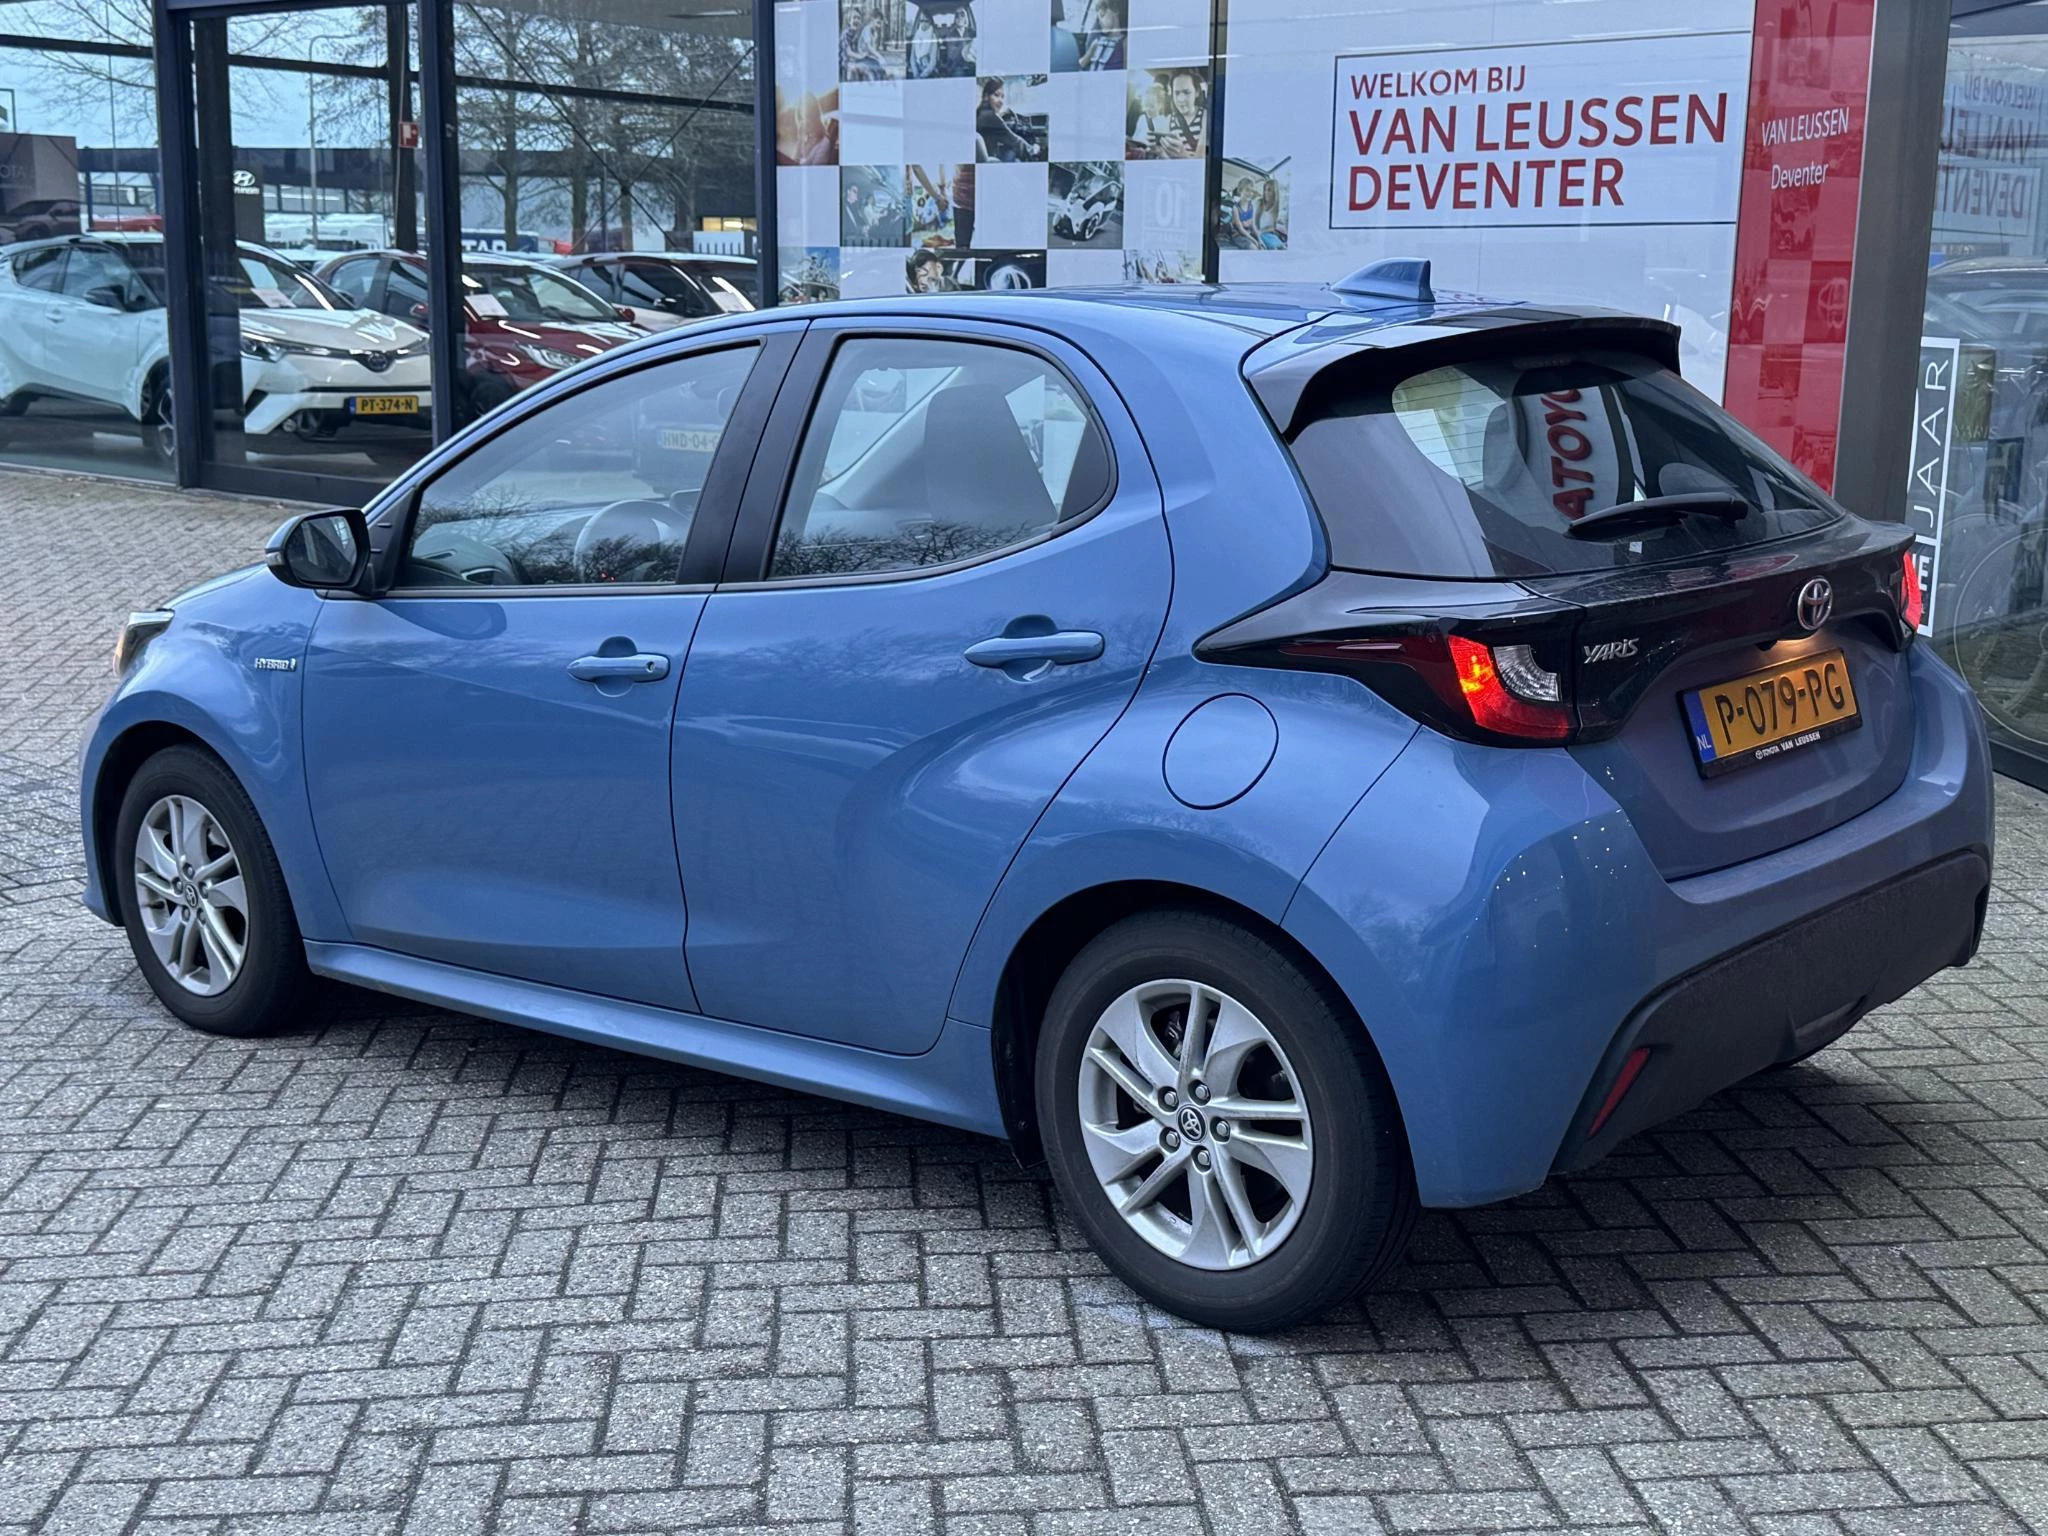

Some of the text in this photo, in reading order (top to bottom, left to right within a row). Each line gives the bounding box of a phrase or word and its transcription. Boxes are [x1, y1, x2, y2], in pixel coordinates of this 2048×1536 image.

[1351, 65, 1527, 100] WELKOM BIJ
[1349, 92, 1729, 156] VAN LEUSSEN
[1762, 107, 1850, 147] VAN LEUSSEN
[1348, 157, 1625, 212] DEVENTER
[1770, 160, 1829, 190] Deventer
[361, 398, 413, 411] PT-374-N
[1914, 359, 1949, 529] JAAR
[255, 657, 290, 670] HYBRID
[1583, 638, 1640, 665] YARIS
[1713, 663, 1846, 744] P-079-PG
[1696, 735, 1712, 751] NL
[1762, 730, 1821, 758] TOYOTA VAN LEUSSEN
